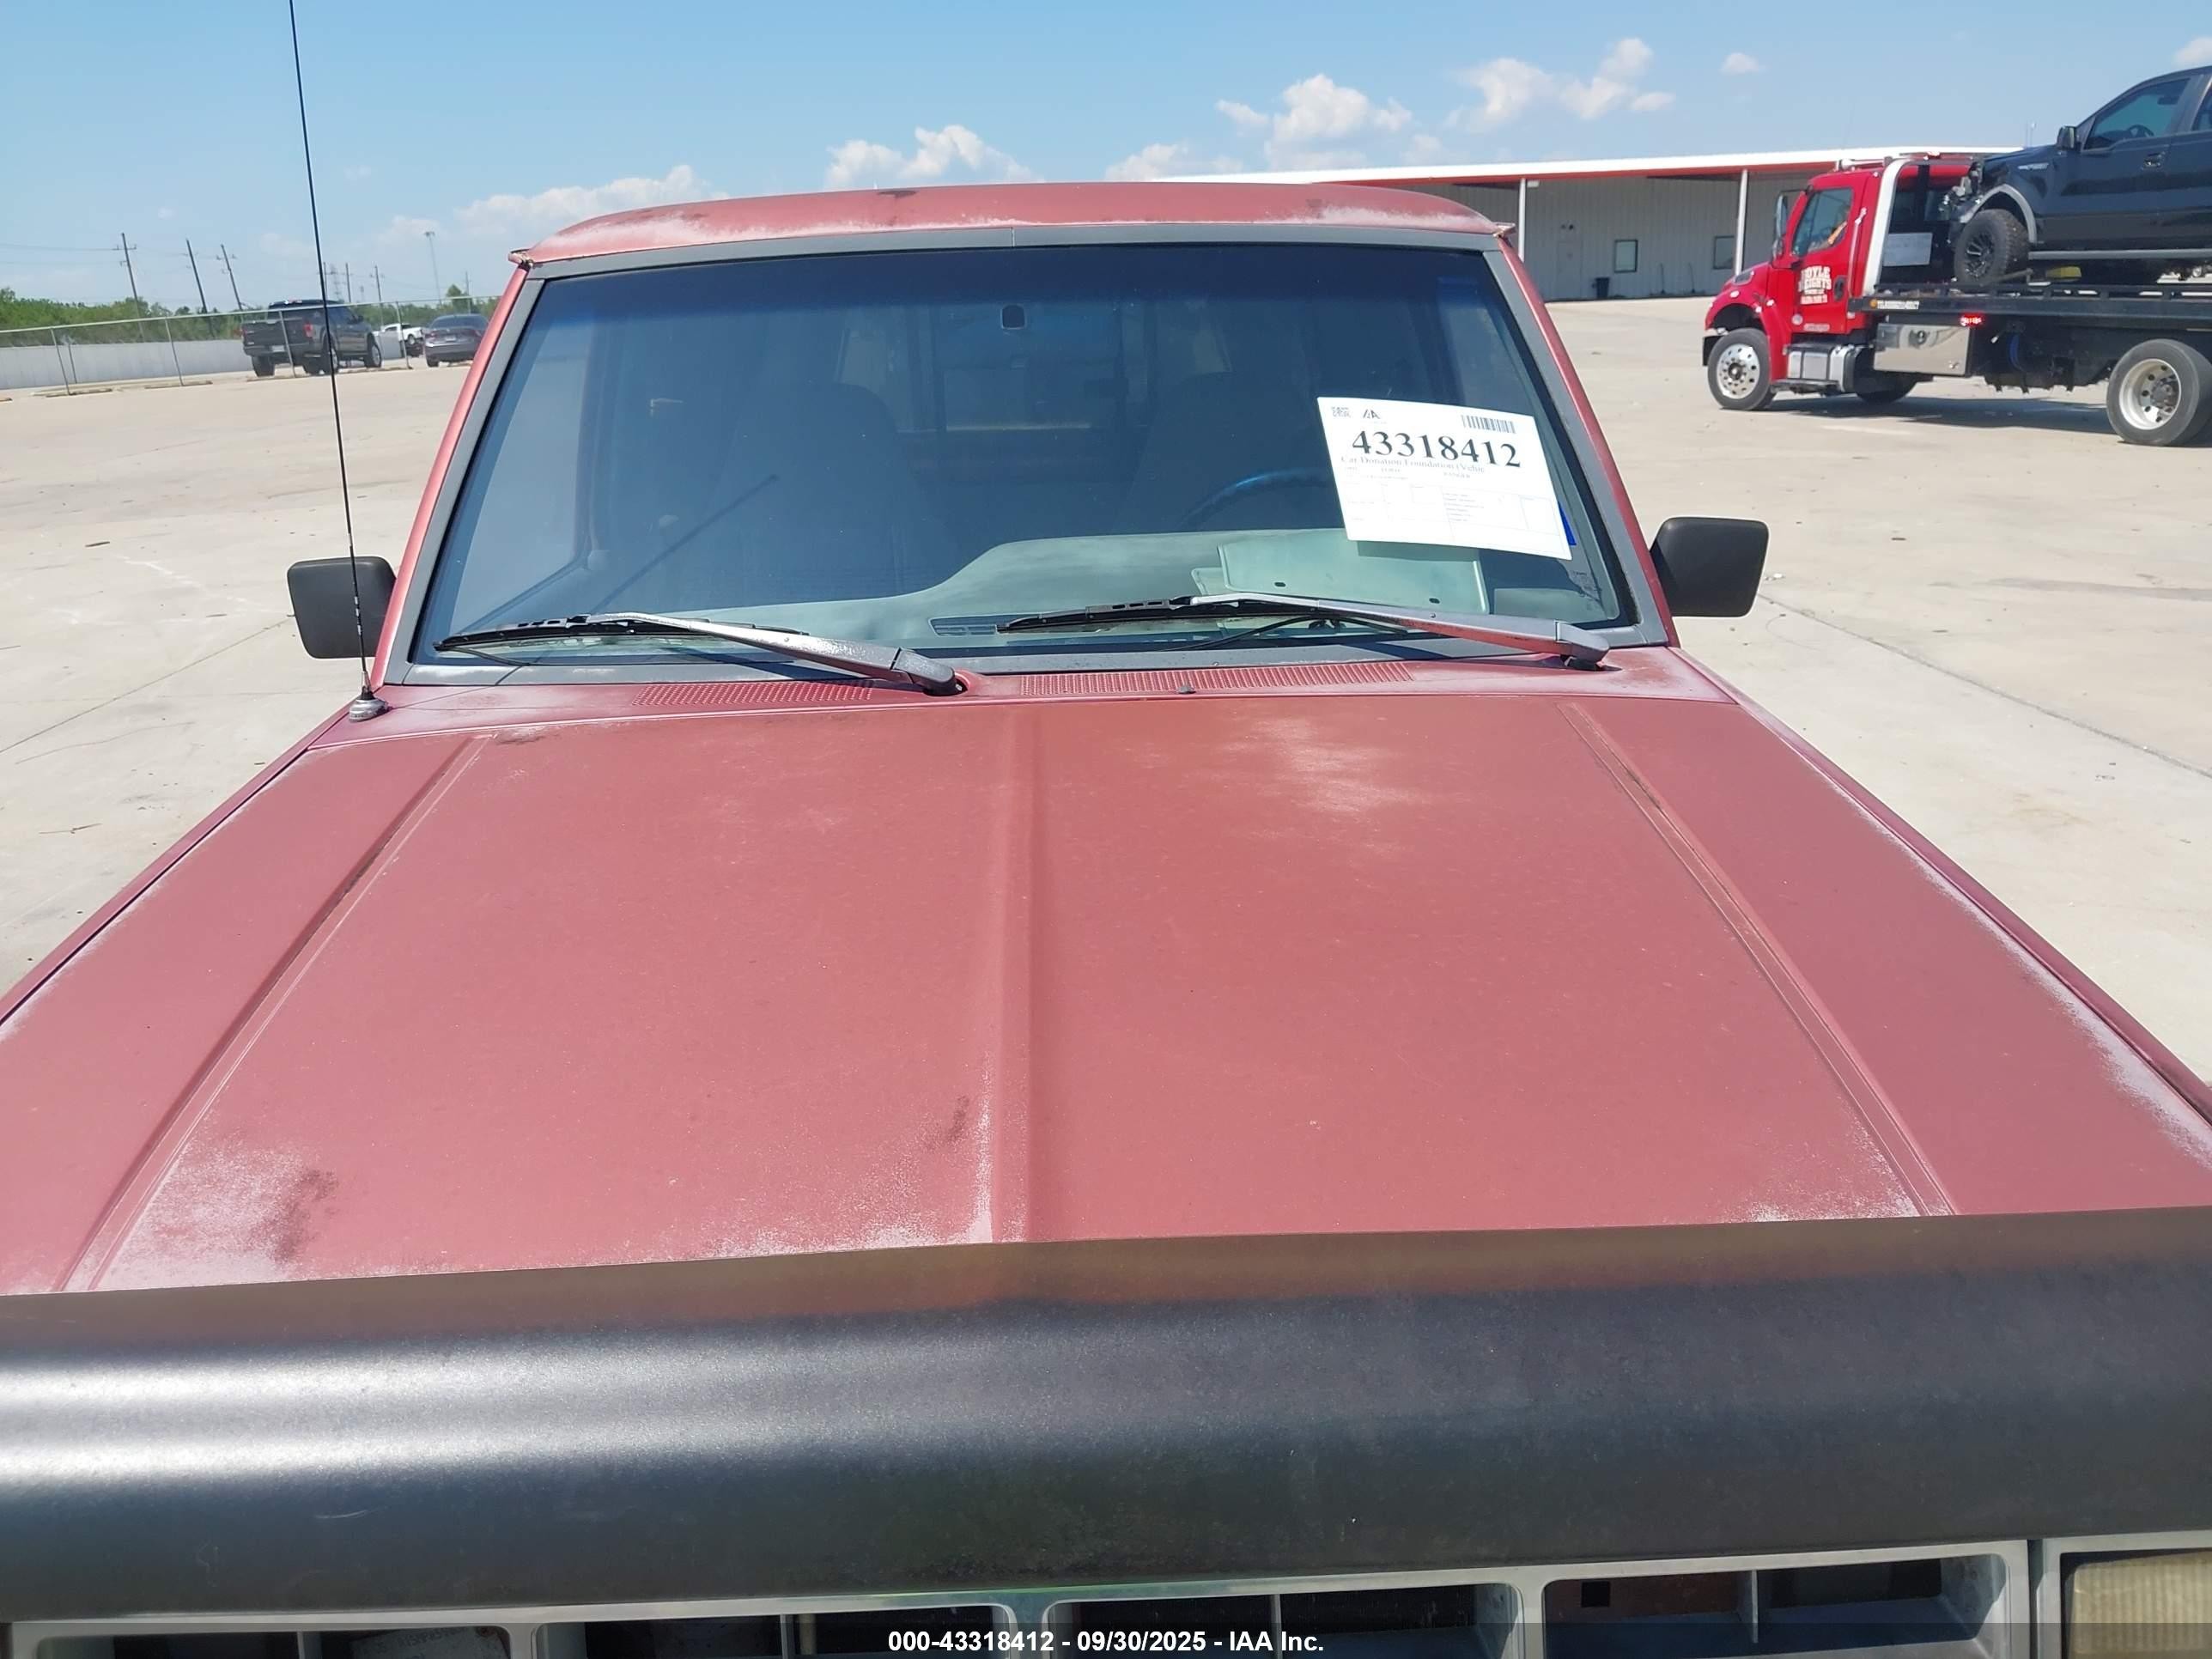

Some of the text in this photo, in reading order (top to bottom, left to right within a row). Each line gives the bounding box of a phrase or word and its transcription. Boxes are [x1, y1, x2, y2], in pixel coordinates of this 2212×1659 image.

[1352, 430, 1521, 468] 43318412
[1360, 456, 1403, 467] Donation
[1405, 459, 1455, 470] Foundation
